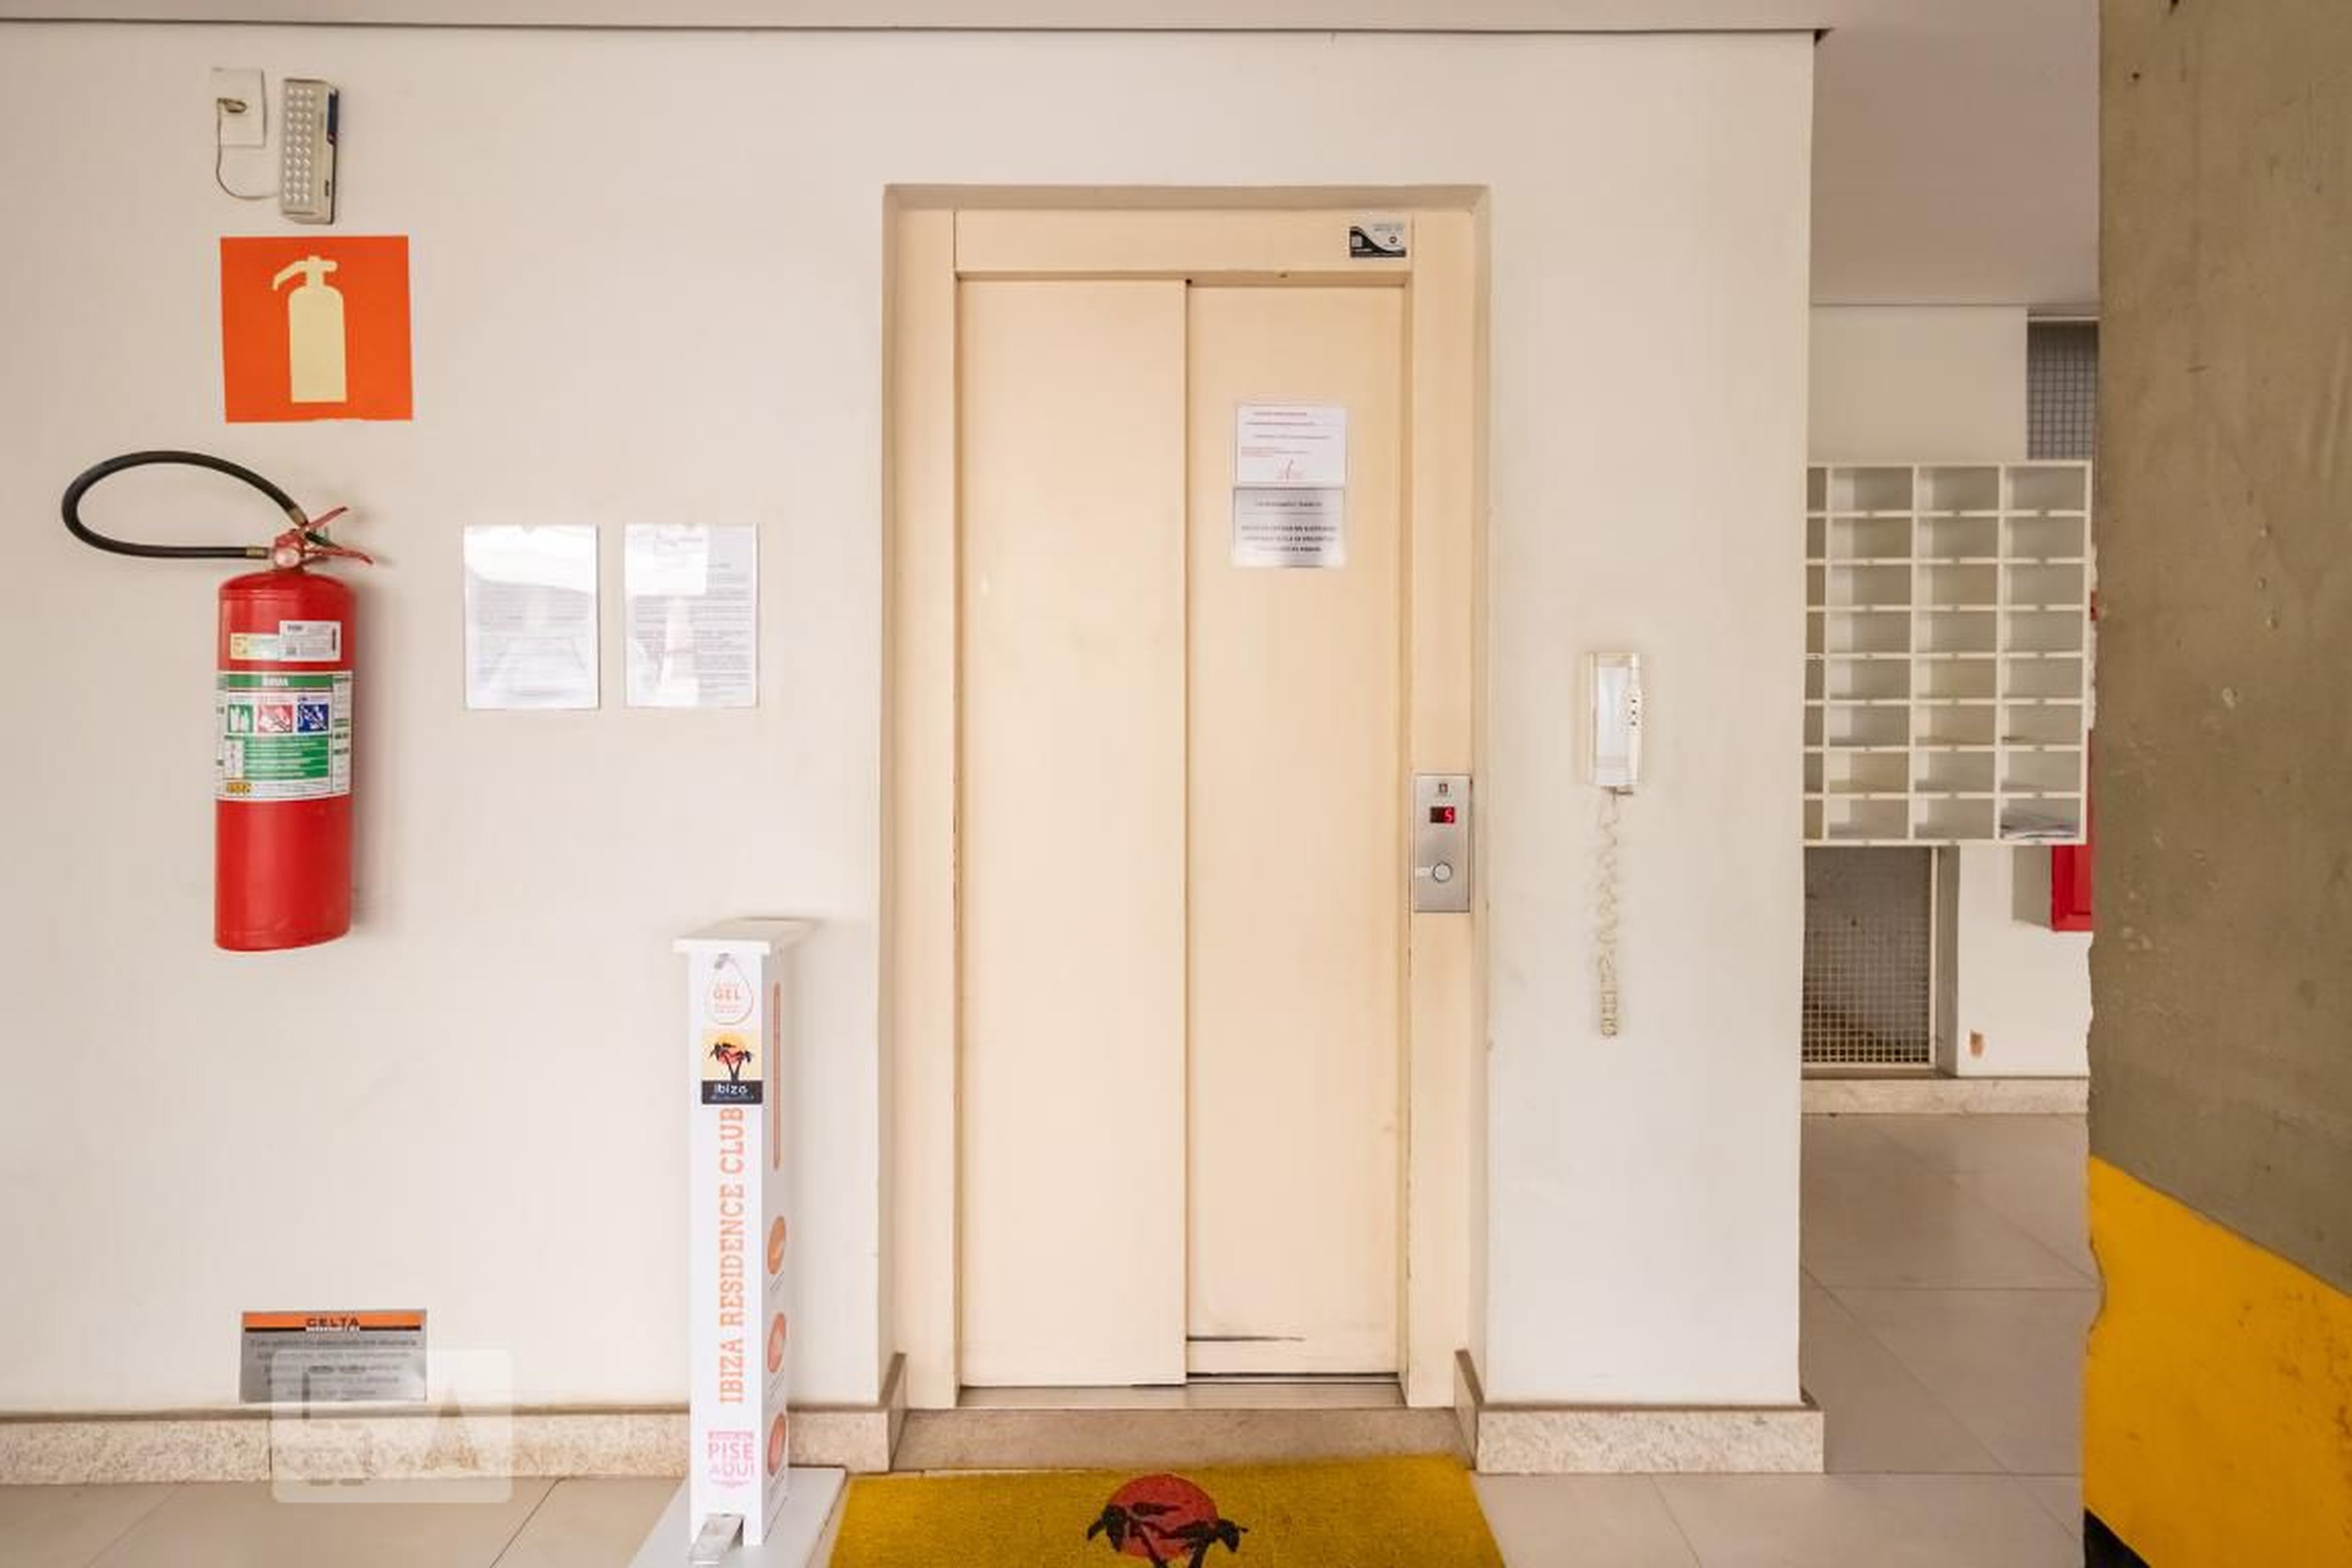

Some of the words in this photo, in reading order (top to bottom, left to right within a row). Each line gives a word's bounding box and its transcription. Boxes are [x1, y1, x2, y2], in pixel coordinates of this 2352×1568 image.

[712, 989, 742, 1000] GEL
[719, 1107, 744, 1175] CLUB
[719, 1184, 744, 1328] RESIDENCE
[306, 1317, 360, 1328] CELTA
[719, 1339, 744, 1404] IBIZA
[708, 1442, 754, 1460] PISE
